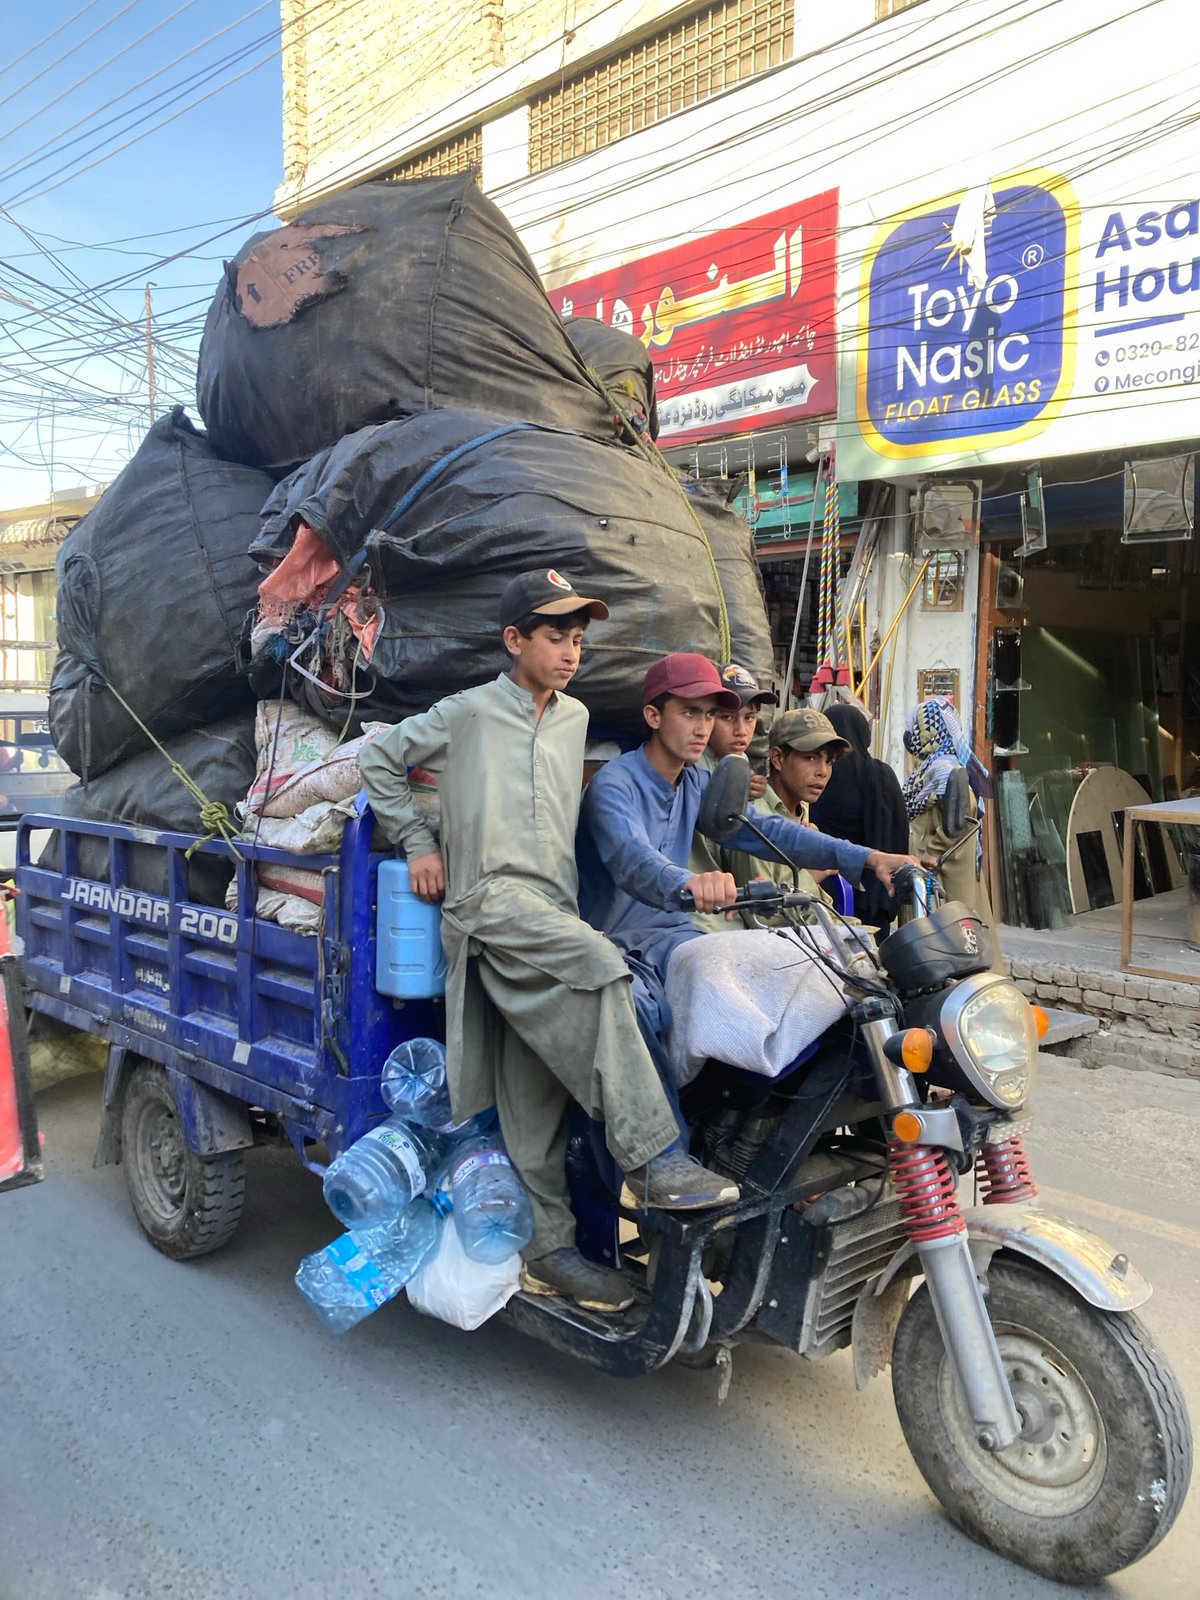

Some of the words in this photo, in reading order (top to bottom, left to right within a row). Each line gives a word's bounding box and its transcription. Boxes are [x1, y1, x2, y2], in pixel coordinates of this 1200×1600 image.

[1095, 199, 1200, 259] Asa
[908, 273, 1019, 331] Toyo
[1095, 256, 1200, 312] Hou
[896, 327, 1030, 391] Nasic
[1115, 333, 1200, 363] 0320-82
[673, 403, 693, 427] نزد
[694, 397, 714, 421] روڈ
[884, 394, 952, 425] FLOAT
[961, 379, 1042, 411] GLASS
[61, 878, 169, 926] JAANDAR
[179, 907, 239, 944] 200
